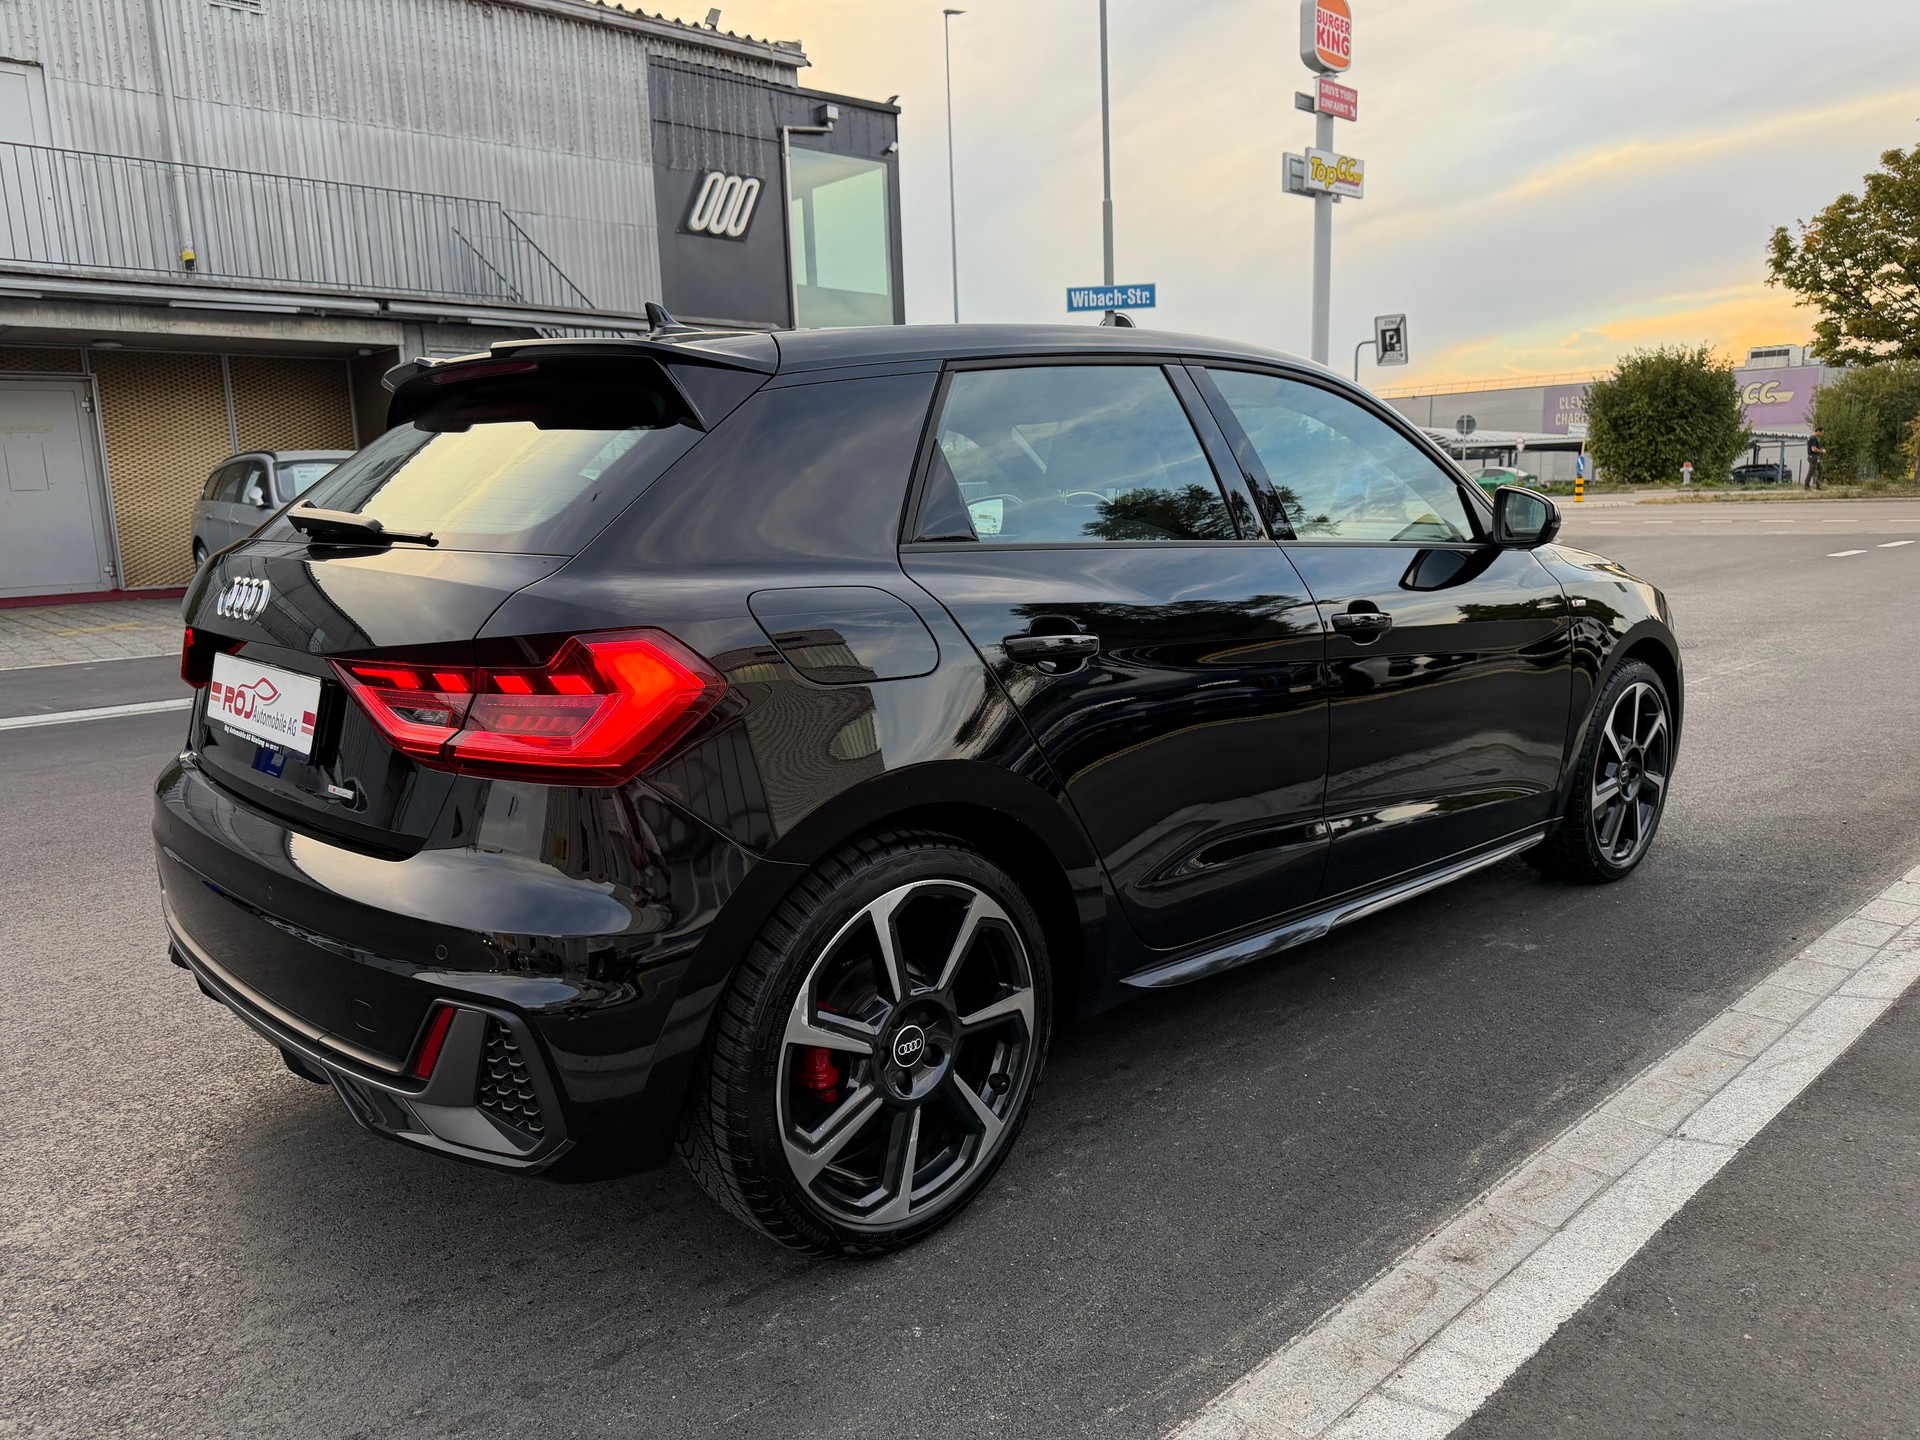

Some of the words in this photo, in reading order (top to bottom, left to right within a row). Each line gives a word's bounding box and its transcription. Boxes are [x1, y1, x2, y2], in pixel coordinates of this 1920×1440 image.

[1317, 9, 1350, 34] BURGER
[1317, 25, 1350, 56] KING
[1321, 83, 1339, 98] DRIVE
[1310, 155, 1356, 190] TopCC
[1071, 288, 1150, 308] Wibach-Str.
[223, 685, 256, 720] ROJ
[252, 705, 287, 734] Automobile
[286, 717, 298, 737] AG
[774, 1190, 830, 1247] UNIROYAL
